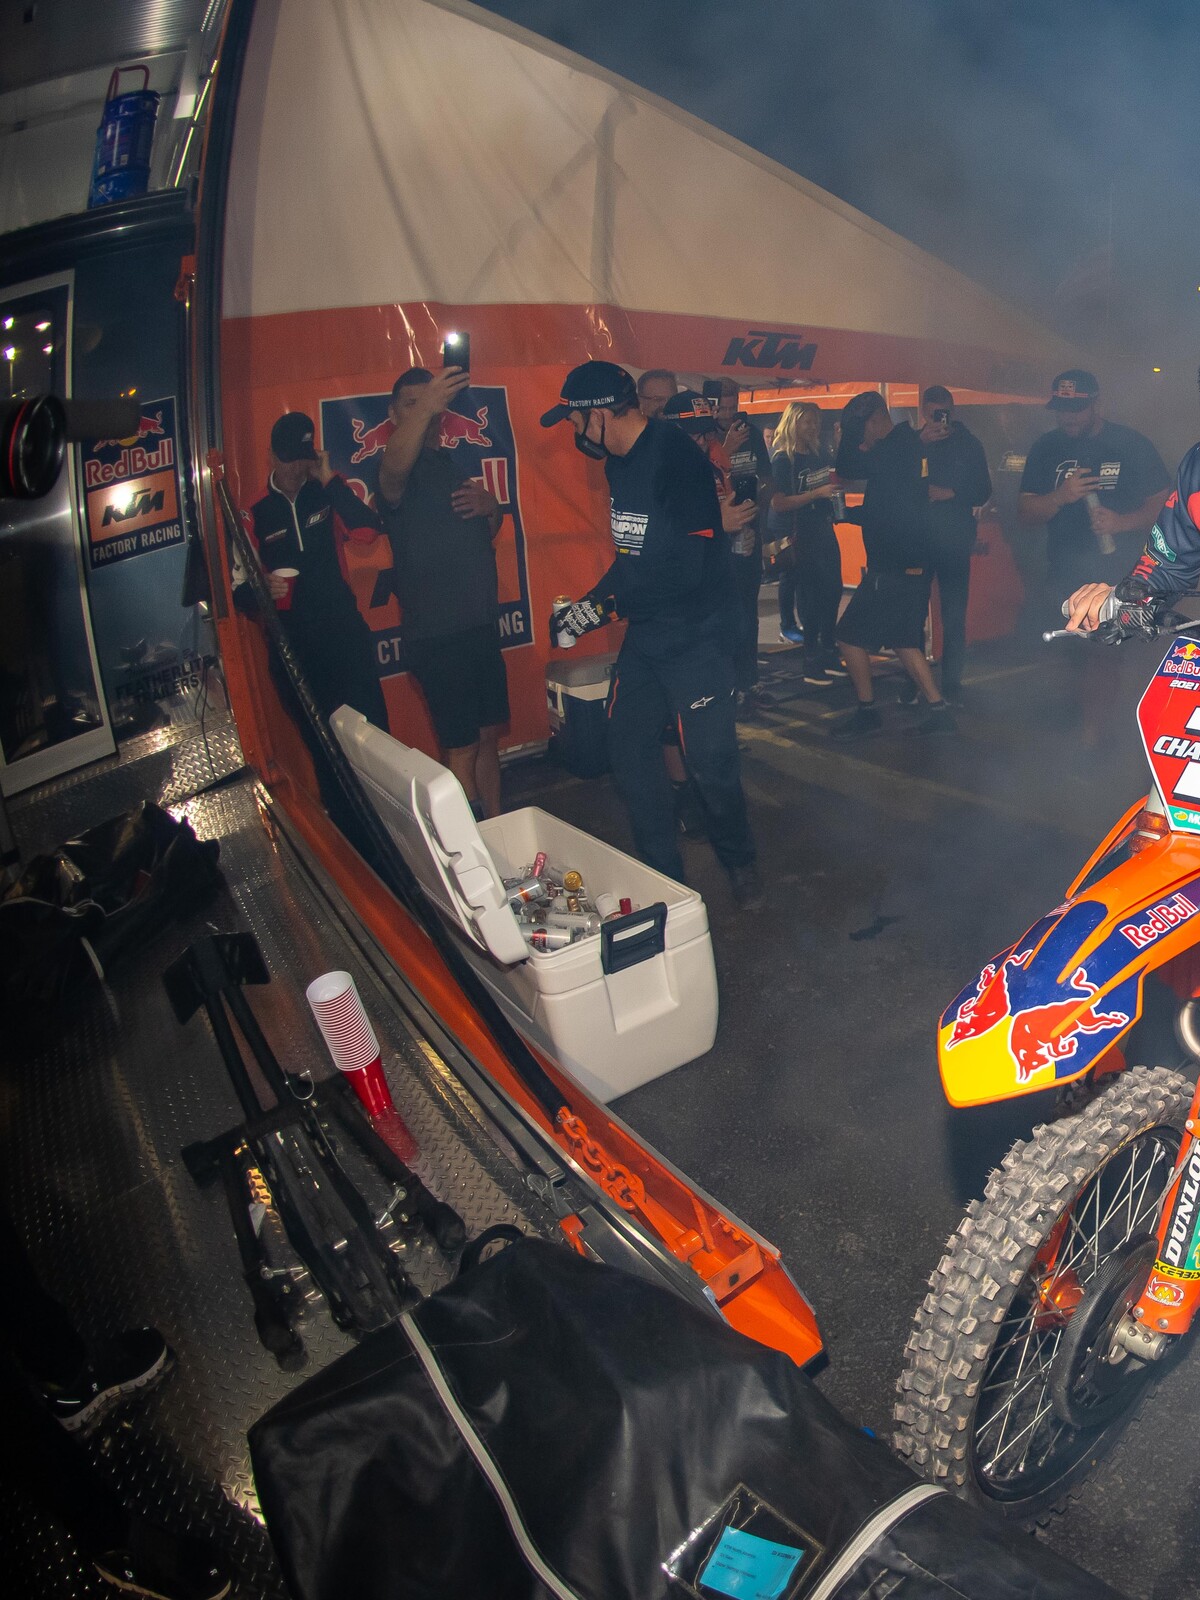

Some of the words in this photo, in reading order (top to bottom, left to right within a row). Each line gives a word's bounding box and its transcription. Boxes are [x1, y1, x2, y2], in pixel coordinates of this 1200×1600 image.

[721, 331, 818, 370] KTM
[569, 399, 592, 408] FACTORY
[593, 396, 615, 406] RACING
[85, 449, 130, 488] Red
[130, 438, 174, 475] Bull
[102, 488, 165, 527] KTM
[93, 536, 138, 562] FACTORY
[141, 524, 181, 547] RACING
[1151, 525, 1170, 558] OTOREX
[1163, 660, 1185, 674] Red
[1169, 679, 1199, 692] 2021
[1120, 910, 1171, 949] Red
[1153, 892, 1199, 927] Bull
